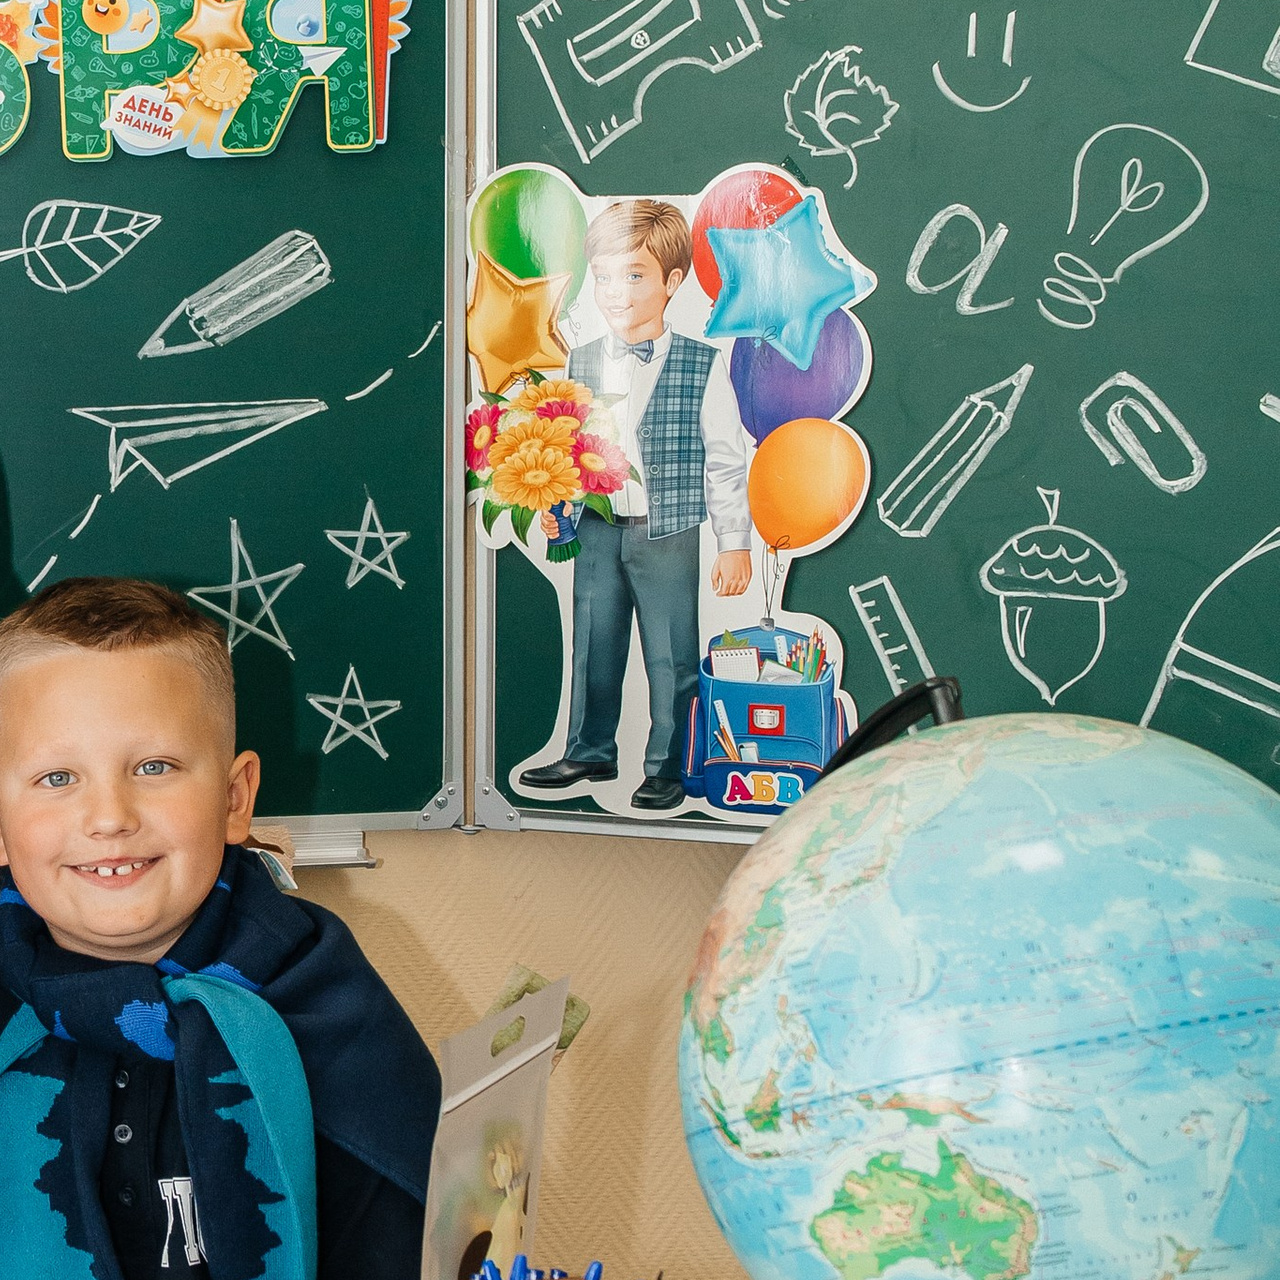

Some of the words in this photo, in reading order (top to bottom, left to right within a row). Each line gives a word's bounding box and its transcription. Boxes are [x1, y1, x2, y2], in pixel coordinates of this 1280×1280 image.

[122, 94, 174, 123] ДЕНЬ
[114, 110, 173, 140] ЗНАНИЙ
[725, 773, 803, 805] АБВ
